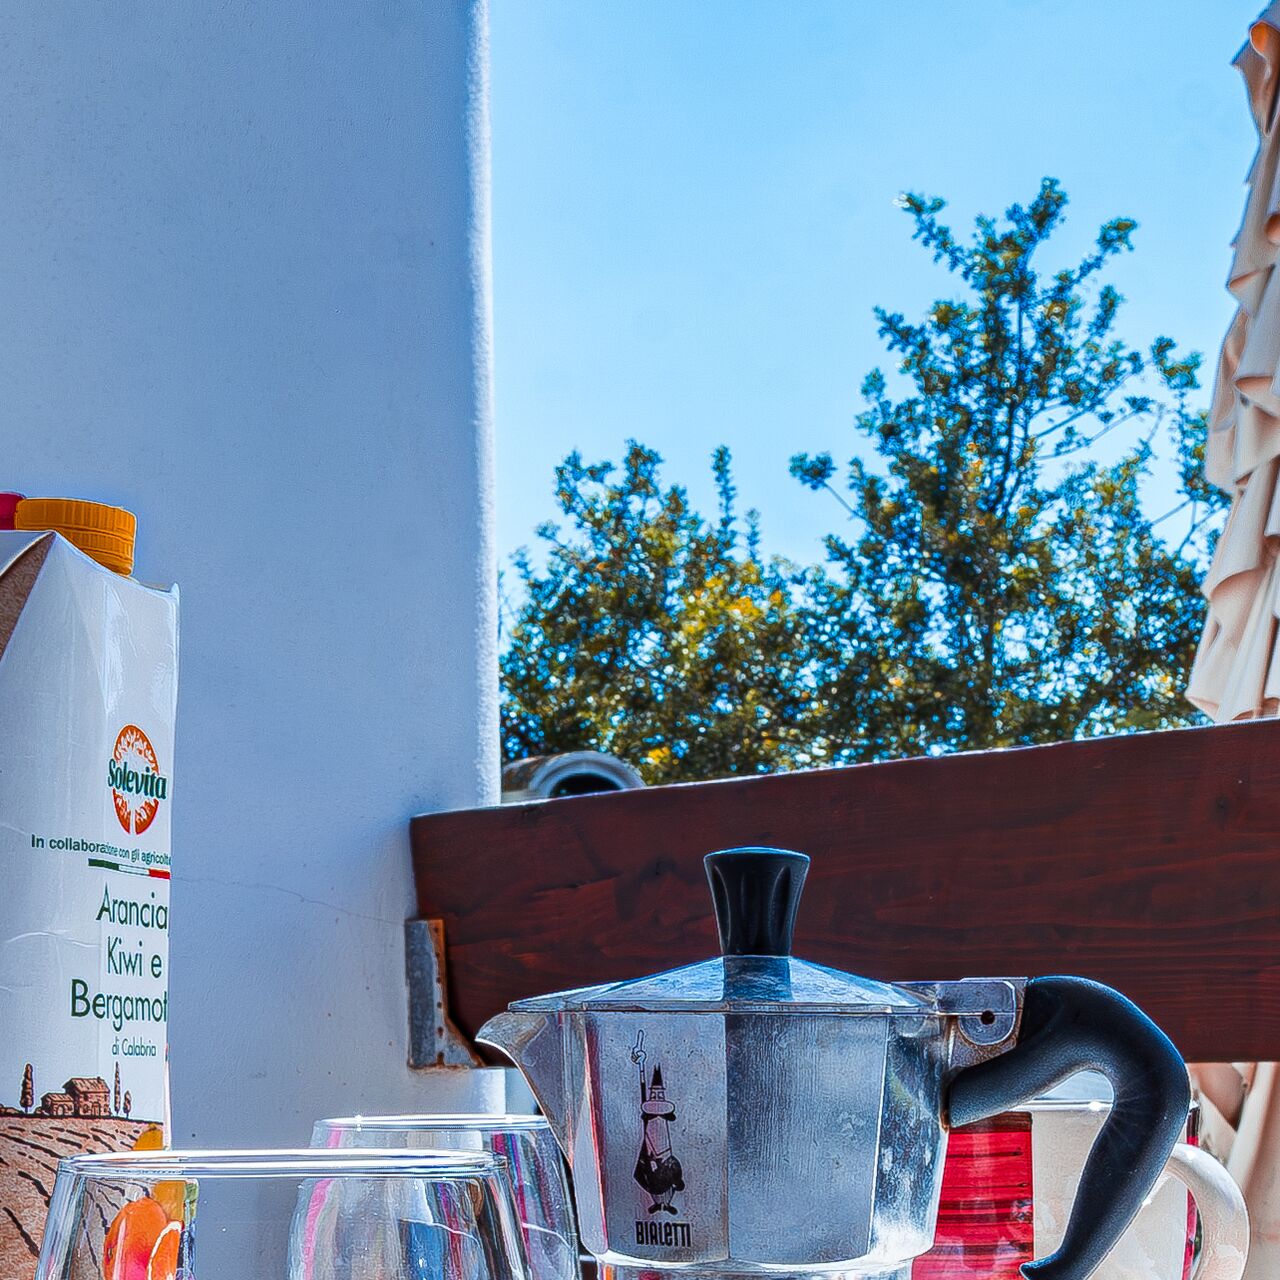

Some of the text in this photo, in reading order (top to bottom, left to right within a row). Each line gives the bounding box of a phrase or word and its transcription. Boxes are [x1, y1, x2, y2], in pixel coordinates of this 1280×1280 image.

[108, 758, 167, 799] Solevita
[31, 834, 45, 848] In
[49, 837, 118, 858] collaborazione
[120, 848, 130, 859] con
[131, 848, 141, 863] gli
[95, 881, 168, 929] Arancia
[108, 936, 162, 979] Kiwi e
[111, 1036, 157, 1057] di Calabria
